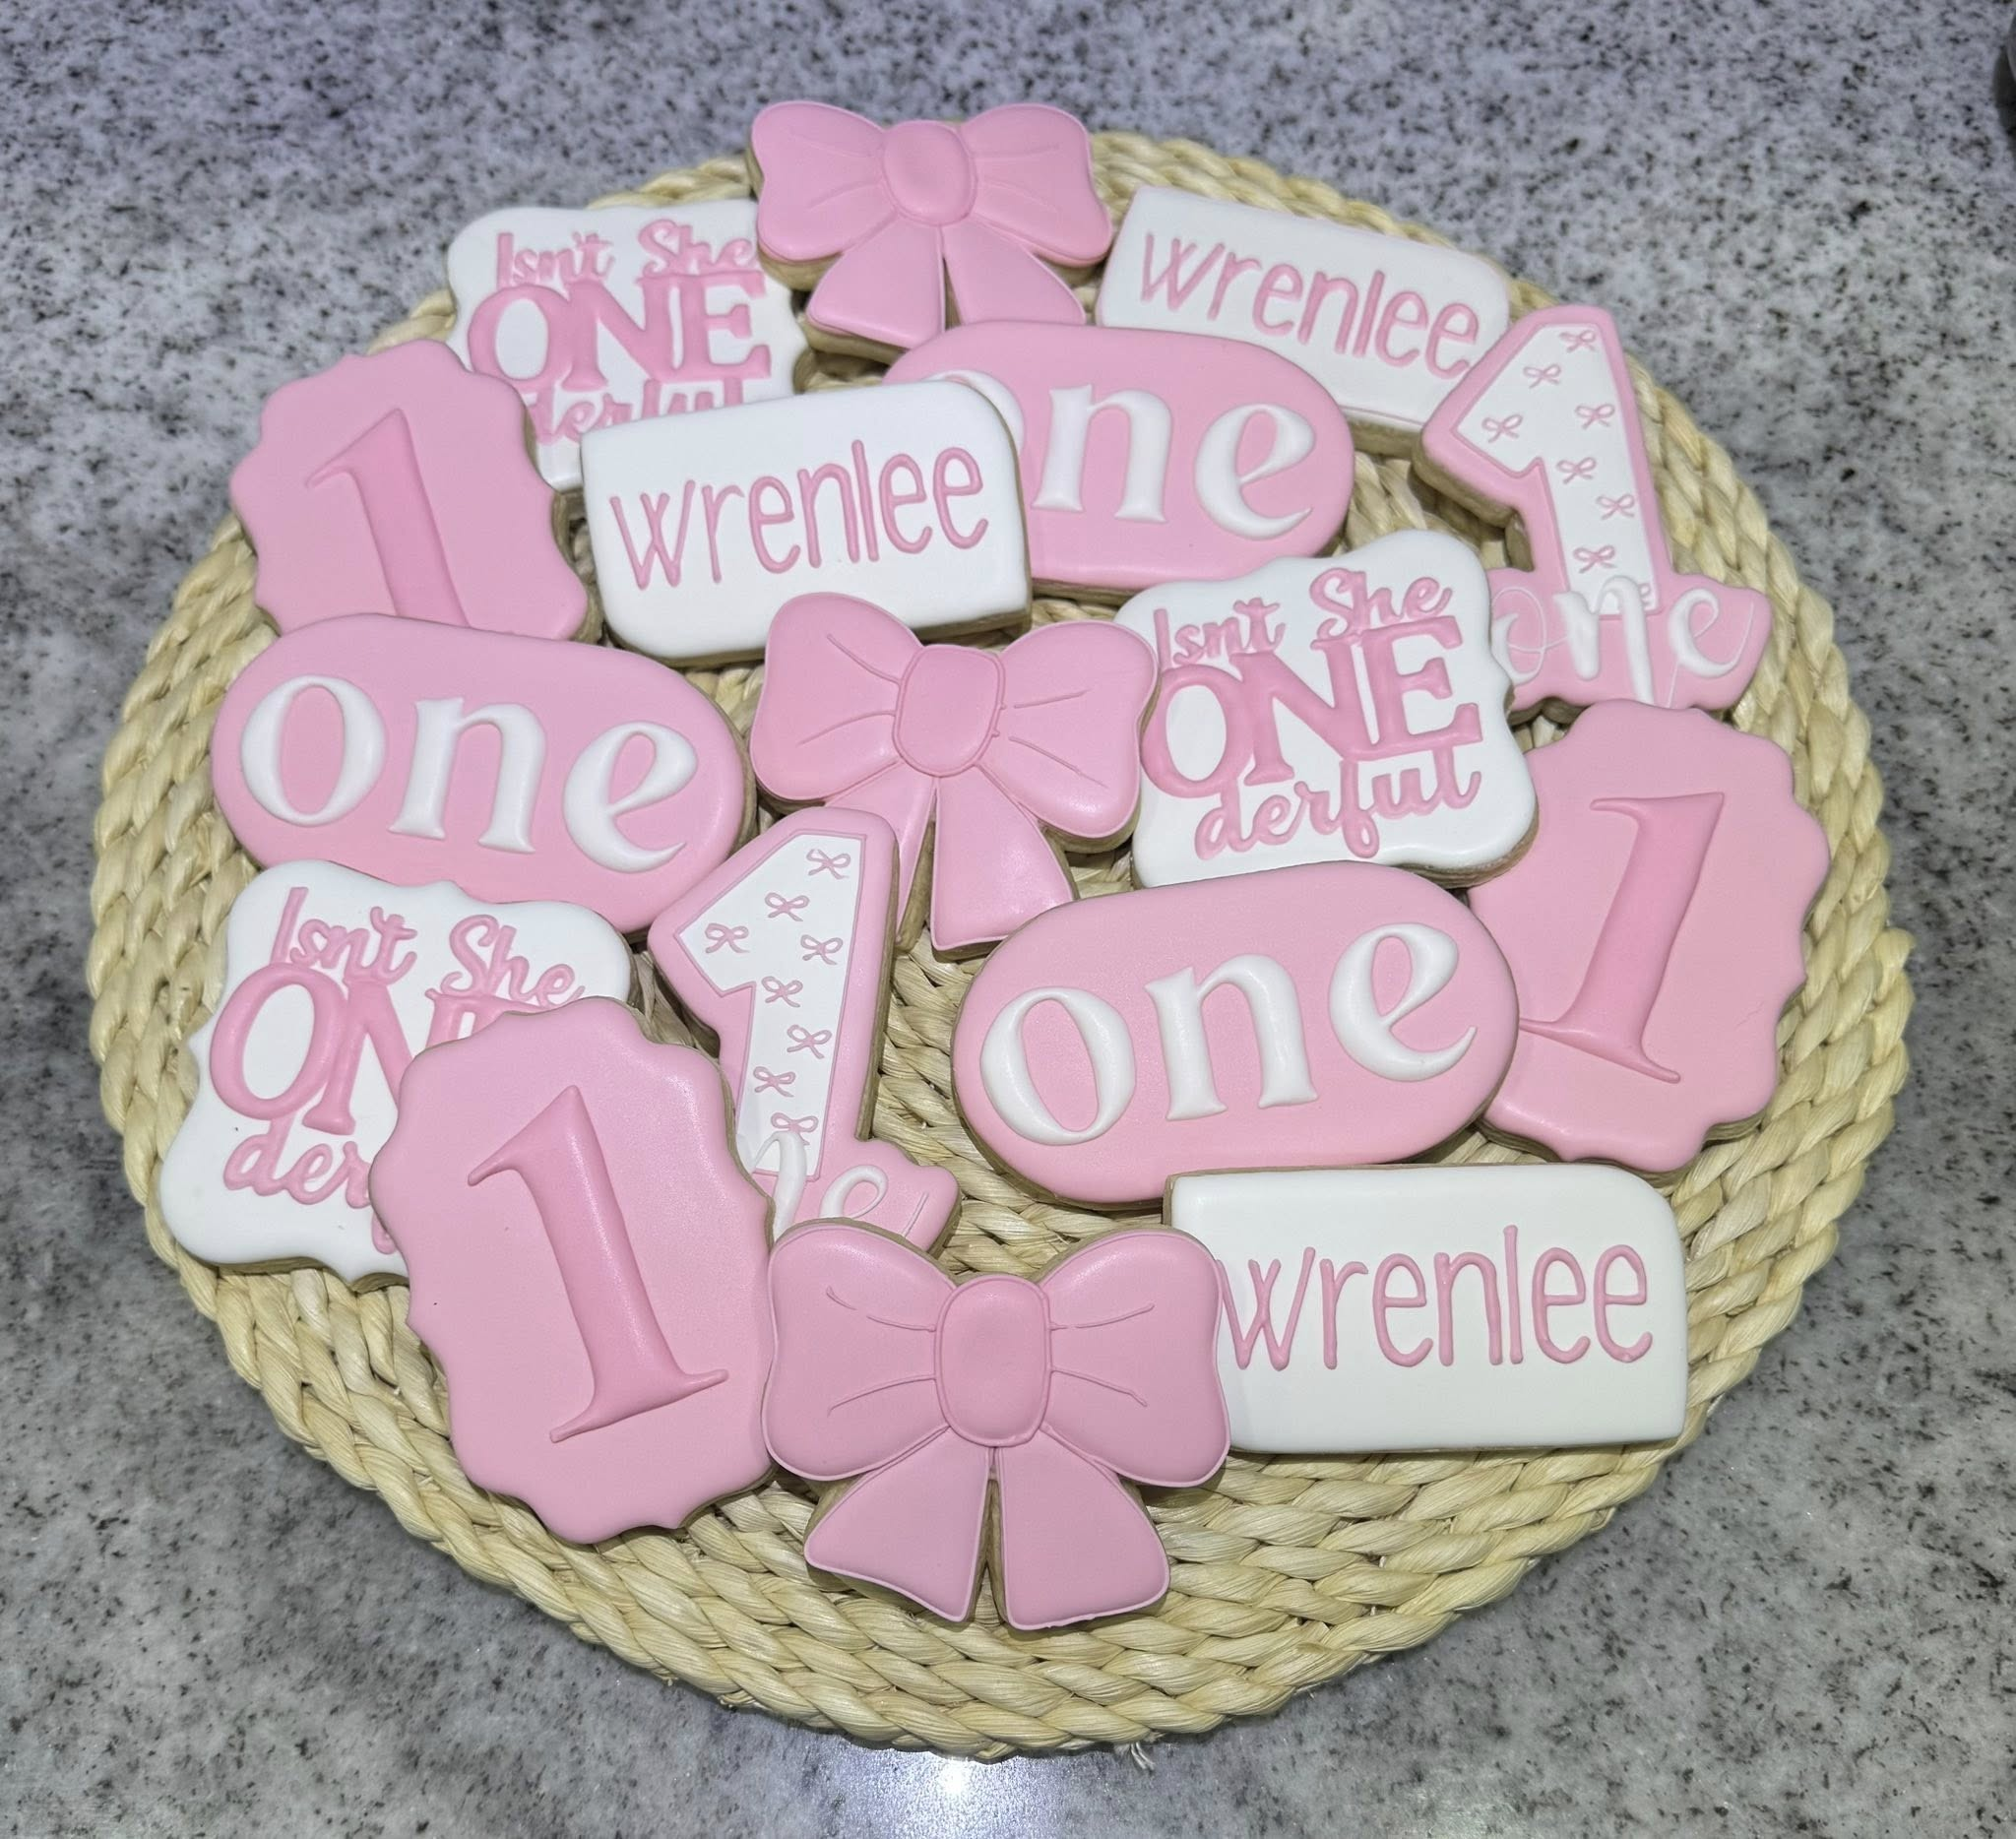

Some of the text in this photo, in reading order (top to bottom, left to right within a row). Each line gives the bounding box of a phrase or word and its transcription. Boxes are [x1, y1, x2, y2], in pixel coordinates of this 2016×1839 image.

[467, 270, 773, 384] ONE
[496, 219, 765, 289] Isn't She
[1140, 232, 1480, 380] wrenlee
[304, 407, 472, 628] 1
[609, 439, 989, 591] wrenlee
[921, 369, 1316, 540] ne
[1308, 567, 1454, 641] She
[1491, 575, 1756, 708] one
[239, 674, 700, 874] one
[1140, 615, 1483, 798] ONE
[1194, 745, 1482, 860] derful
[440, 914, 586, 1007] She
[1518, 792, 1726, 1084] 1
[209, 962, 546, 1135] ON
[979, 922, 1479, 1146] one
[736, 1131, 930, 1243] ne
[467, 1085, 729, 1444] 1
[1216, 1224, 1654, 1371] wrenlee
